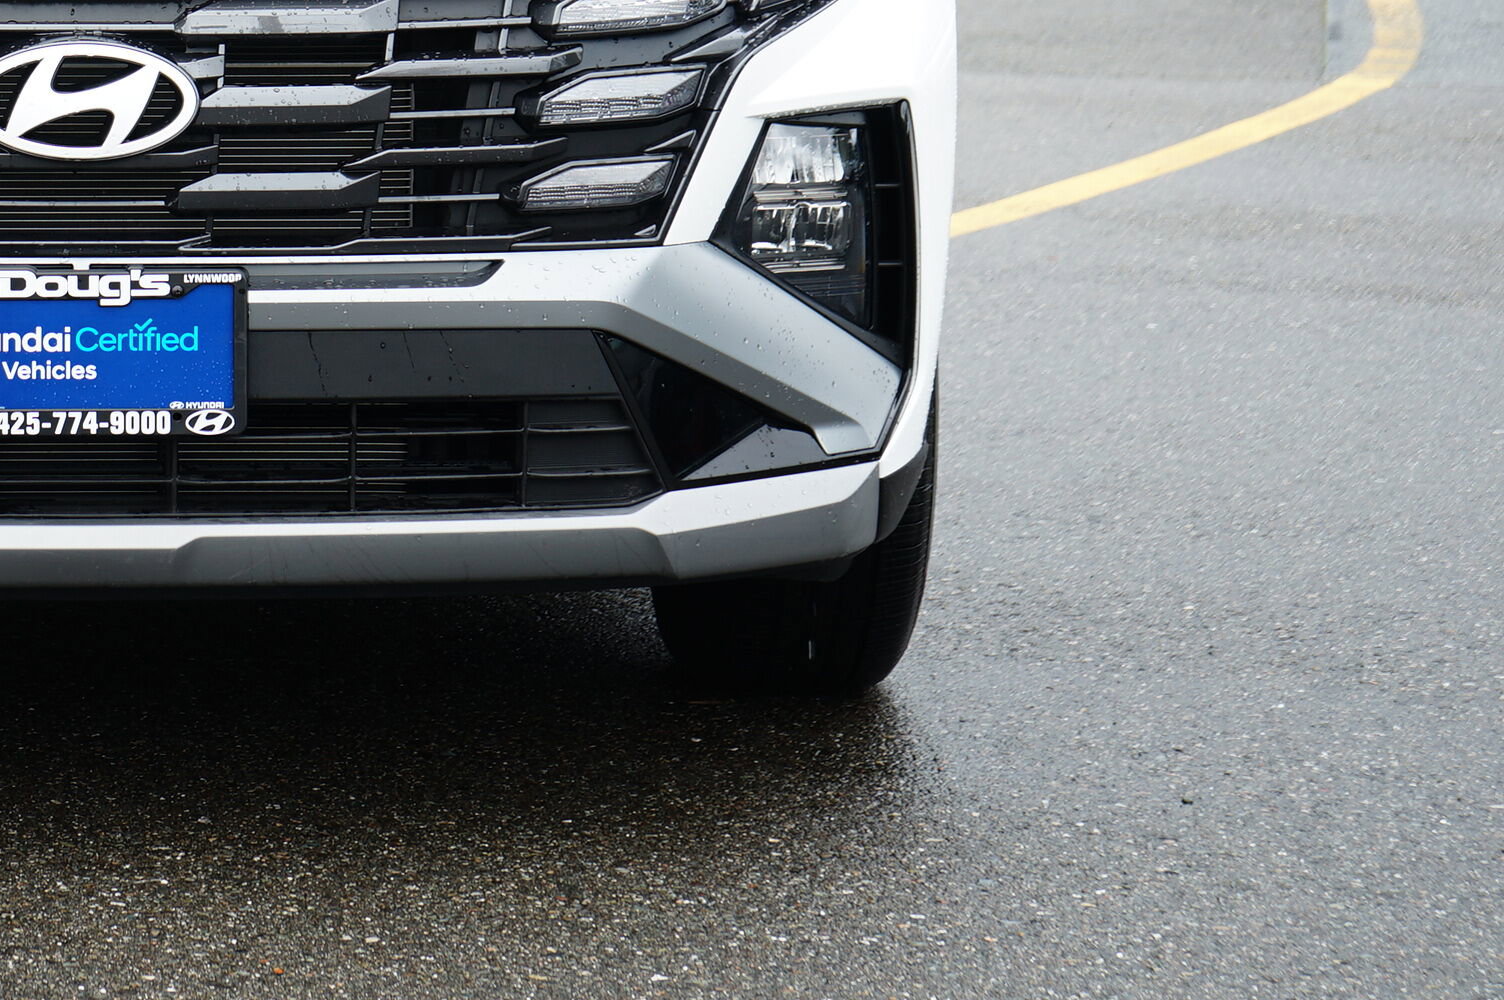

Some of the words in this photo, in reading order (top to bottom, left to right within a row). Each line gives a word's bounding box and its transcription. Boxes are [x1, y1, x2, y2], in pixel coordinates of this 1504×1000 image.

[183, 273, 242, 284] LYNNWOOD
[75, 318, 199, 352] Certified
[2, 360, 98, 380] Vehicles
[185, 401, 225, 409] HYUNDAI
